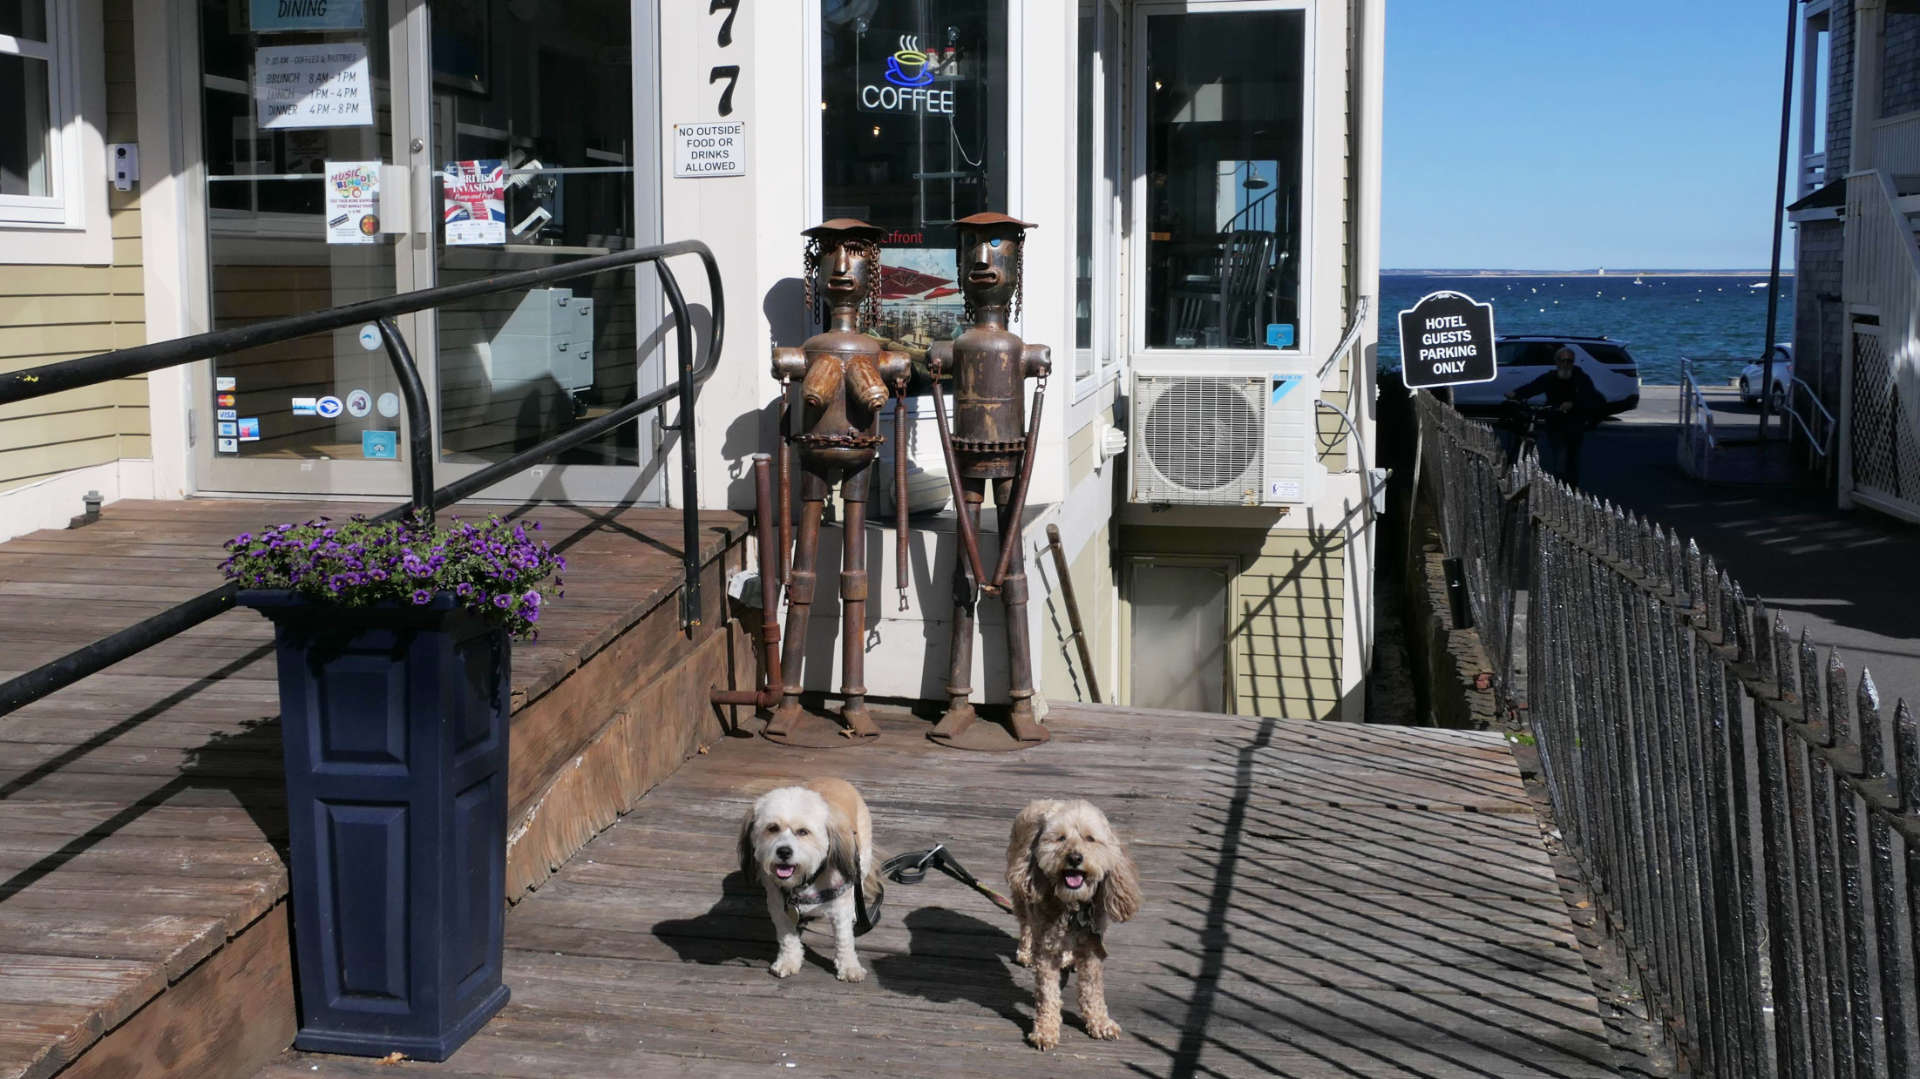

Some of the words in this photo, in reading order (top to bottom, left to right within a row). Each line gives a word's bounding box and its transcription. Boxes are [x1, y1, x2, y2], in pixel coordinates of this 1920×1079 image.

[278, 0, 327, 18] DINING
[309, 73, 315, 83] 8
[316, 73, 329, 83] AM
[343, 71, 357, 81] PM
[316, 89, 329, 99] PM
[336, 88, 343, 98] 4
[344, 87, 358, 98] PM
[862, 85, 954, 113] COFFEE
[268, 103, 298, 116] DINNER
[309, 104, 316, 115] 4
[316, 104, 331, 115] PM
[338, 103, 344, 114] 8
[345, 103, 360, 113] PM
[679, 127, 694, 137] NO
[696, 125, 741, 136] OUTSIDE
[686, 138, 716, 148] FOOD
[718, 137, 734, 147] OR
[691, 150, 730, 160] DRINKS
[685, 161, 736, 172] ALLOWED
[330, 168, 362, 183] MUSIC
[453, 183, 496, 193] INVASION
[1425, 315, 1467, 330] HOTEL
[1422, 330, 1472, 345] GUESTS
[1420, 345, 1477, 361] PARKING
[1433, 361, 1466, 375] ONLY
